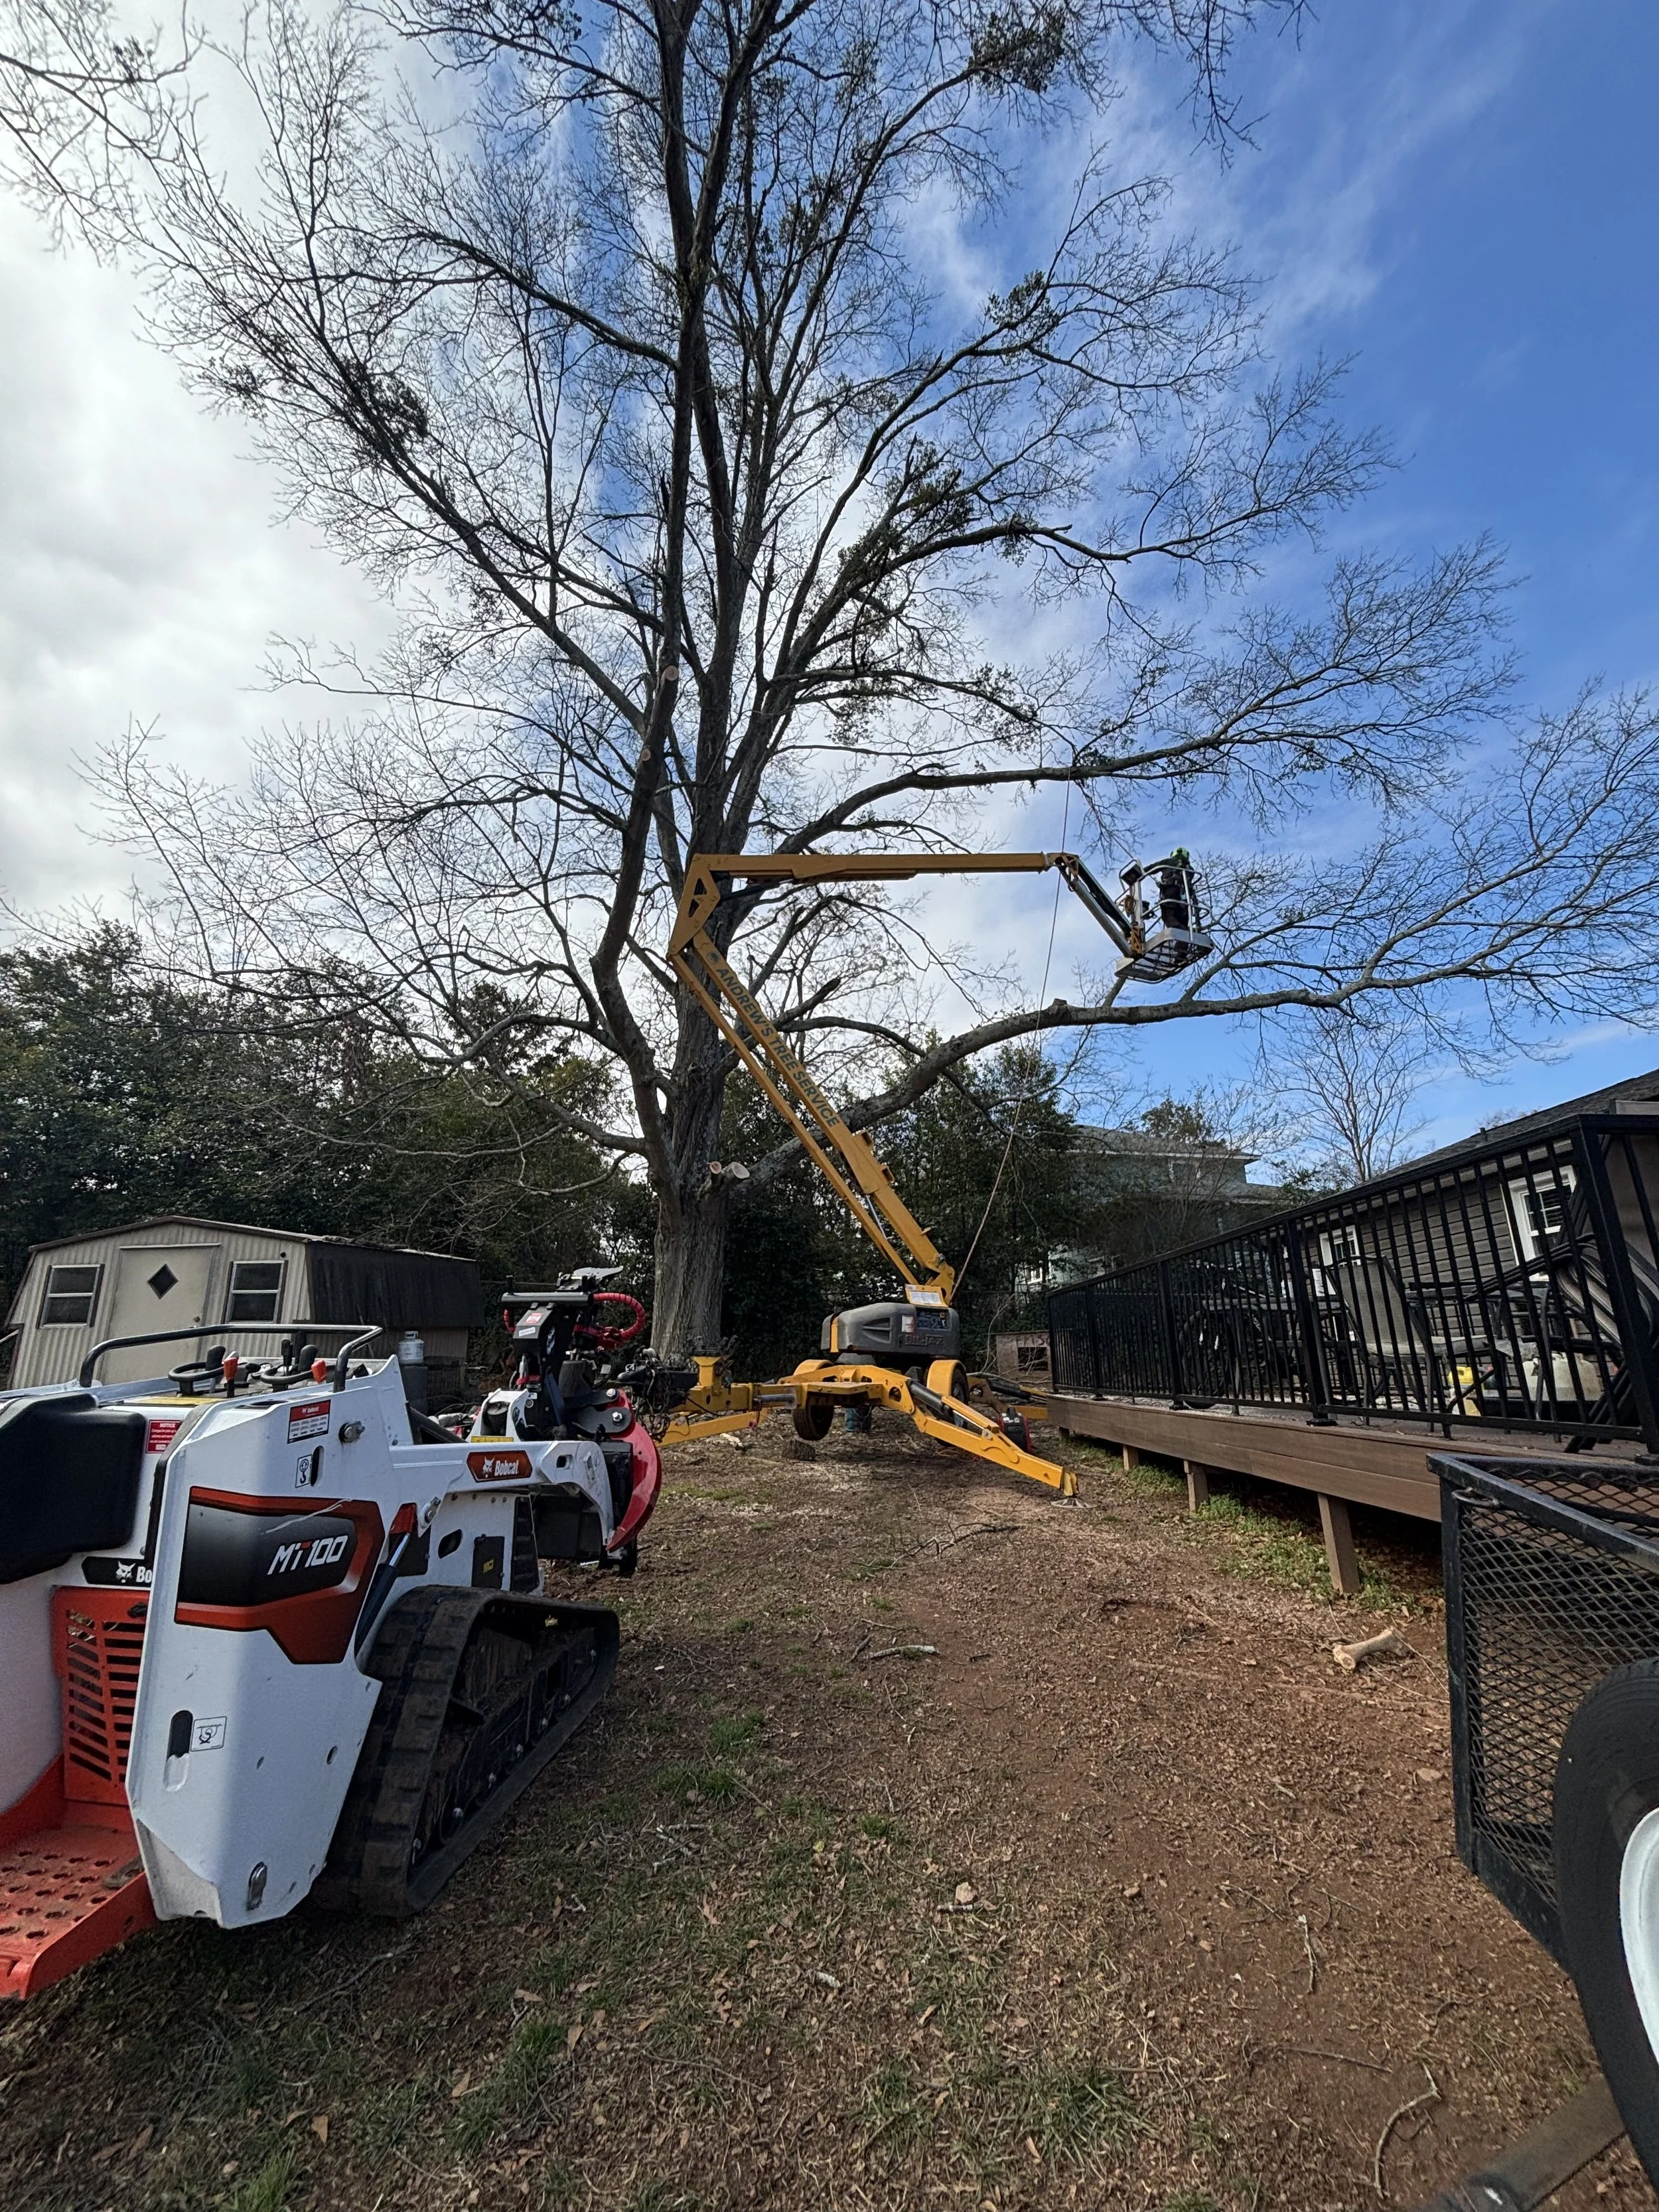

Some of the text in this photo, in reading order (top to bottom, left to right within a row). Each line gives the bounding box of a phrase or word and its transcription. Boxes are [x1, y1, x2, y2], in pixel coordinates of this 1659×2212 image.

[715, 968, 839, 1127] ANDREW'S TREE SERVICE
[494, 1459, 519, 1477] Bobcat
[267, 1534, 348, 1576] MT100
